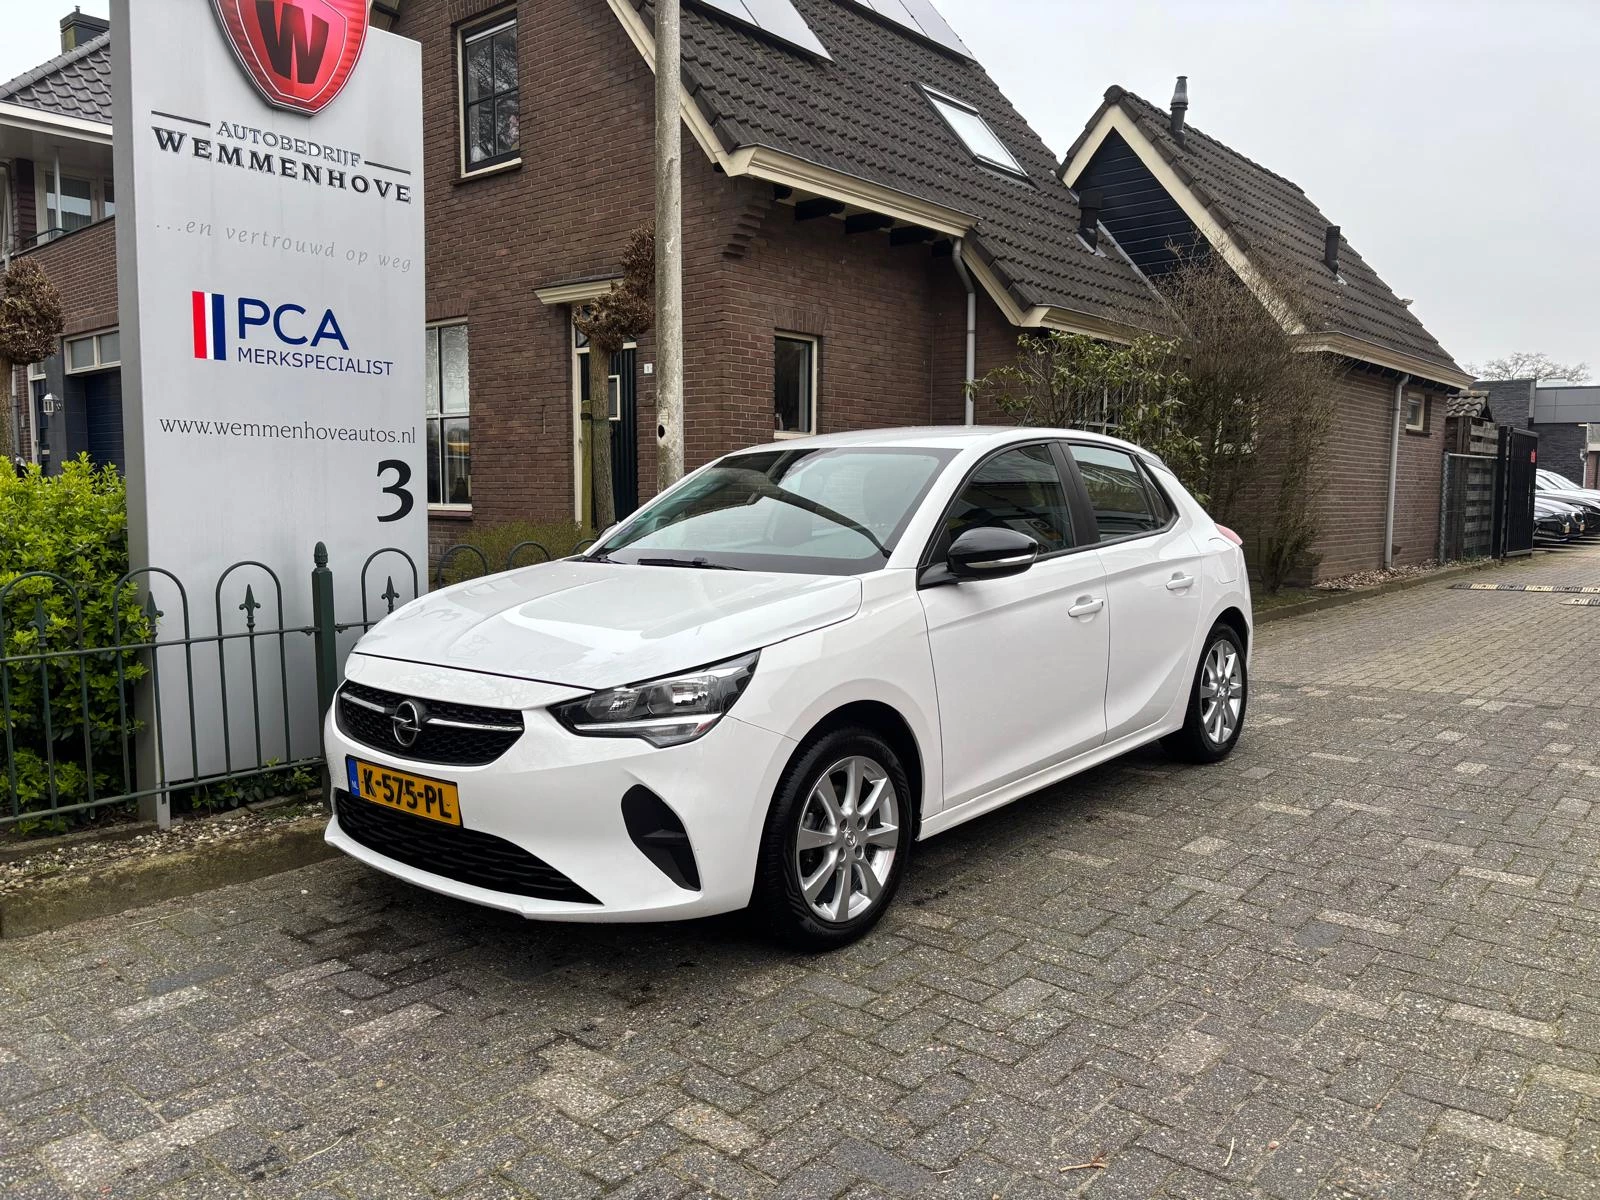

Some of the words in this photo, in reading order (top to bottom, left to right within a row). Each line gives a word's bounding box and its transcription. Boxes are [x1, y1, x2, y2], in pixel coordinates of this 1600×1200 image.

[255, 0, 329, 84] W
[152, 126, 412, 204] WEMMENHOVE
[217, 121, 361, 167] AUTOBEDRIJF
[226, 226, 335, 258] vertrouwd
[345, 248, 368, 264] op
[378, 254, 412, 273] weg
[237, 297, 350, 351] PCA
[238, 347, 393, 376] MERKSPECIALIST
[159, 418, 416, 444] www.wemmenhoveautos.nl
[376, 459, 414, 523] 3
[363, 768, 452, 819] K-575-PL
